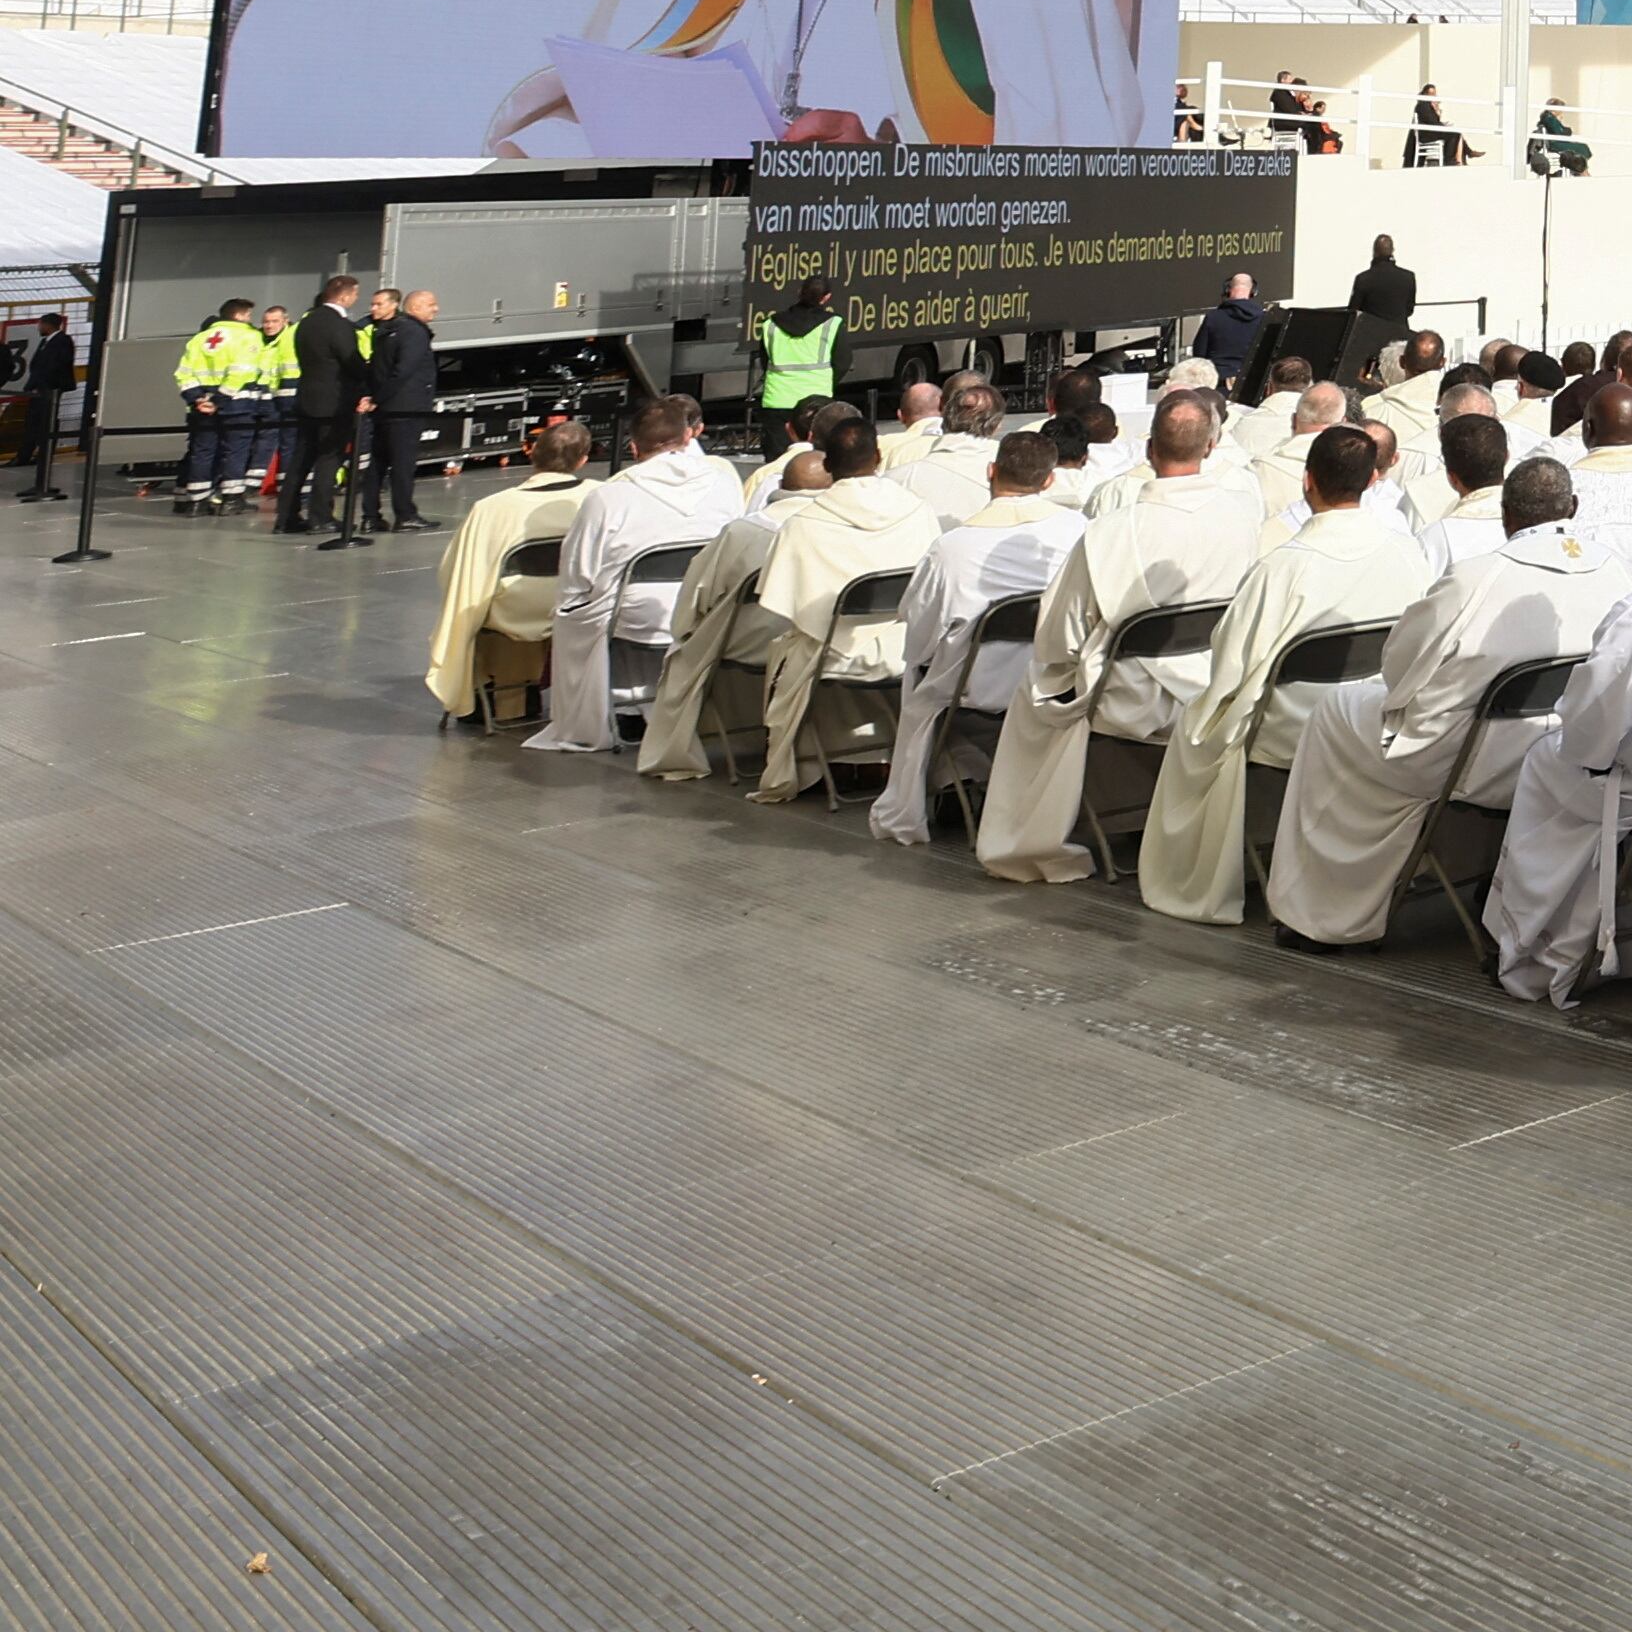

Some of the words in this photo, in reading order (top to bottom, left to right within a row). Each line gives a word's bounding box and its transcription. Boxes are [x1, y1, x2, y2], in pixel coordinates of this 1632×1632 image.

[758, 141, 887, 186] bisschoppen.
[893, 143, 920, 177] De
[925, 145, 1021, 177] misbruikers
[1024, 148, 1081, 178] moeten
[1084, 148, 1137, 178] worden
[1140, 149, 1221, 178] veroordeeld.
[1224, 150, 1255, 177] Deze
[1257, 151, 1292, 177] ziekte
[755, 203, 793, 233] van
[798, 194, 880, 232] misbruik
[885, 196, 931, 229] moet
[935, 194, 997, 229] worden
[1000, 199, 1072, 234] genezen.
[828, 241, 841, 279] il
[843, 248, 858, 287] y
[861, 245, 898, 278] une
[902, 238, 952, 283] place
[956, 242, 997, 280] pour
[999, 236, 1039, 269] tous.
[1043, 234, 1064, 267] Je
[1067, 241, 1104, 265] vous
[1107, 229, 1174, 263] demande
[1177, 229, 1194, 259] de
[1197, 234, 1214, 258] ne
[1216, 231, 1240, 264] pas
[1242, 224, 1284, 255] couvrir
[847, 295, 876, 333] De
[881, 293, 909, 330] les
[914, 291, 961, 327] aider
[964, 287, 975, 322] à
[979, 284, 1031, 330] guerir,
